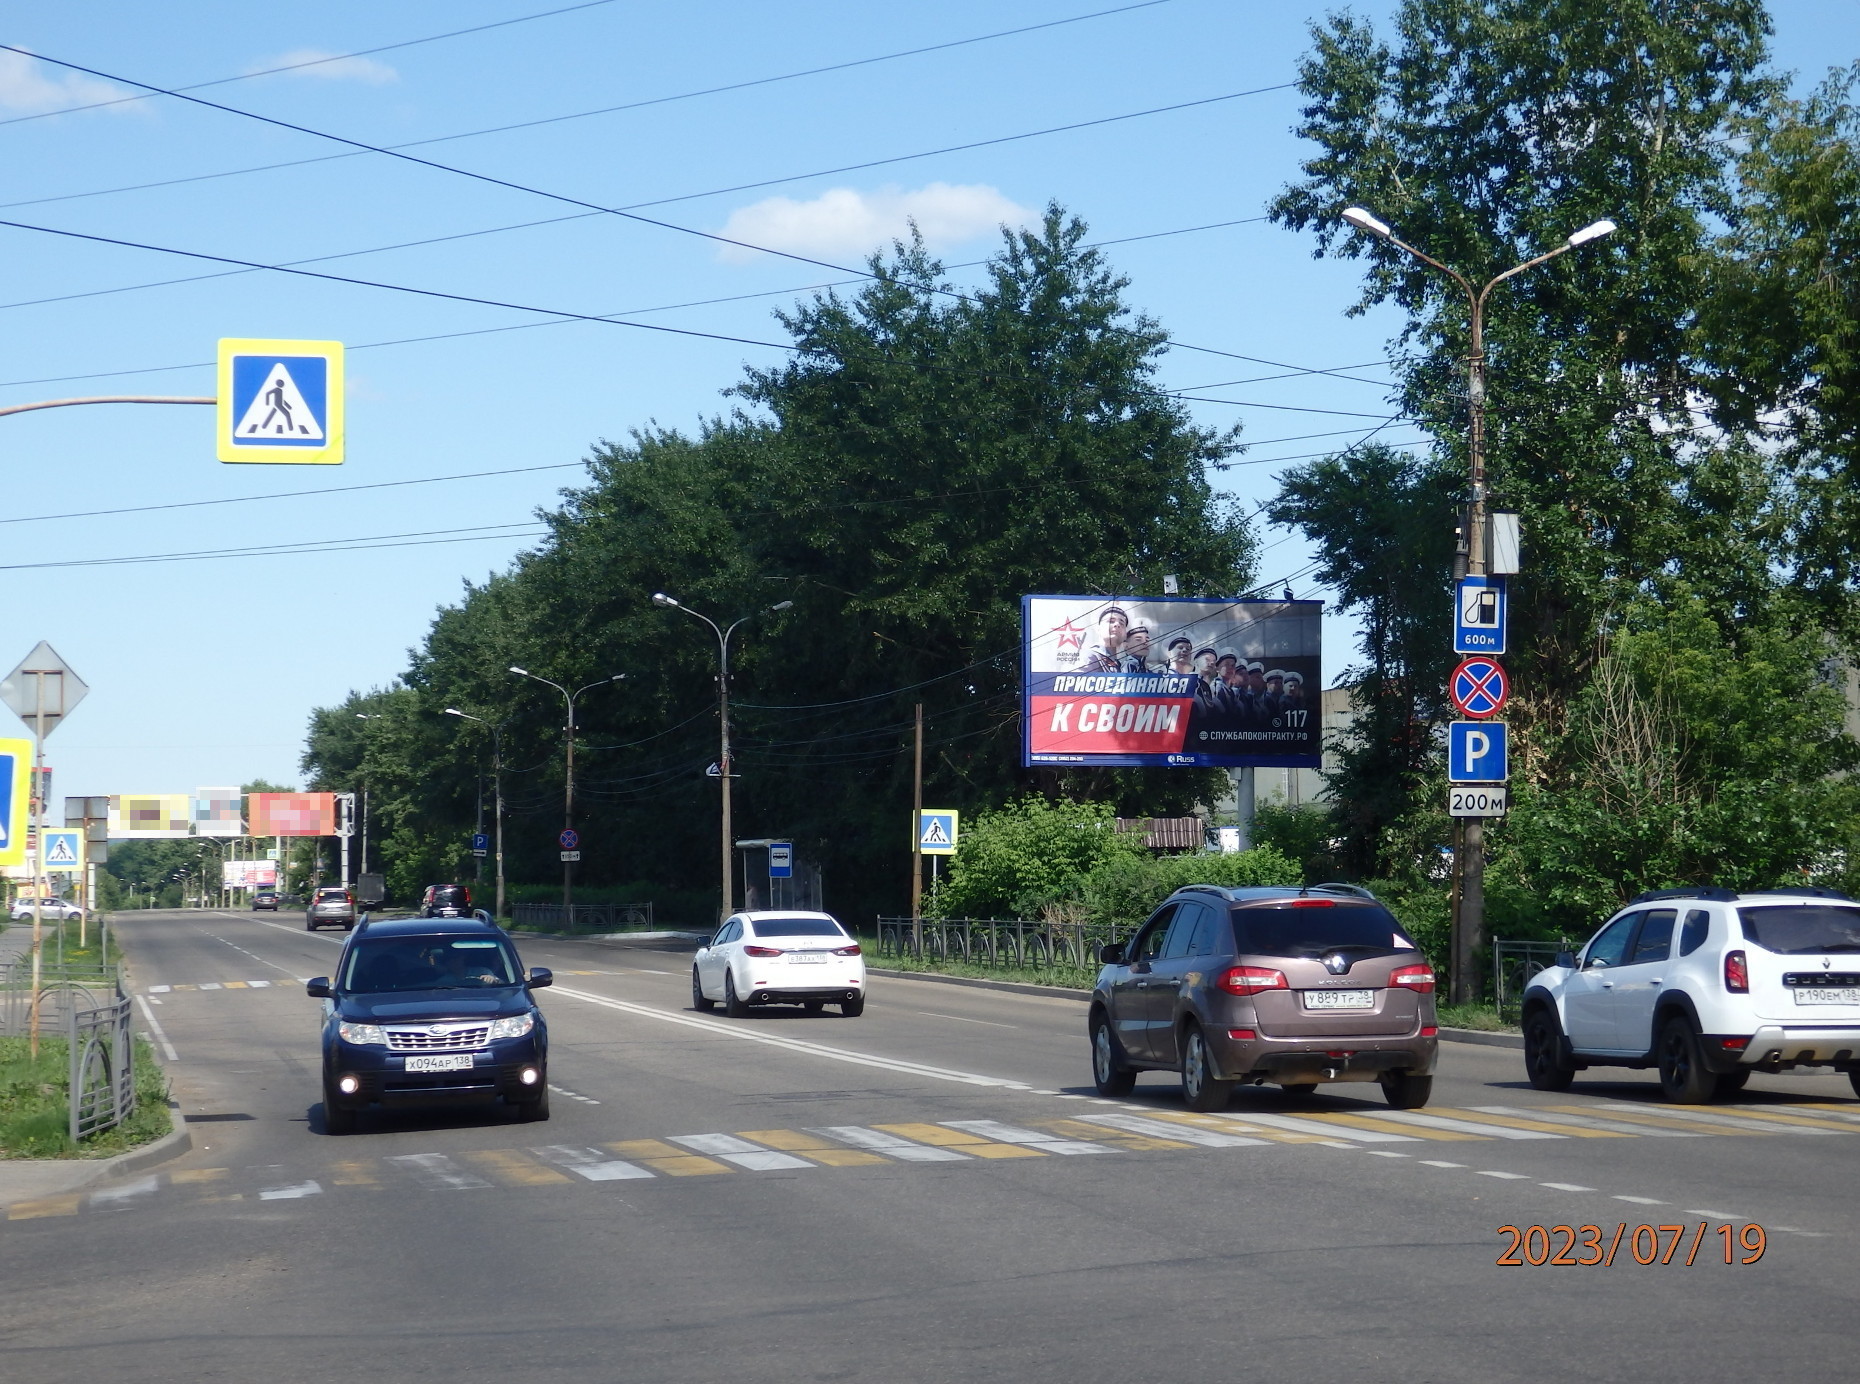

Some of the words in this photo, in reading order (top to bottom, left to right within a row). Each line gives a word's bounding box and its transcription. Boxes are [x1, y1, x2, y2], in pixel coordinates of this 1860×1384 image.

[1053, 674, 1190, 694] ПРИСОЕДИНЯЙСЯ
[1050, 703, 1074, 732] К
[1077, 703, 1181, 733] СВОИМ
[1284, 709, 1308, 728] 117
[1210, 731, 1308, 741] СЛУЖБАПОКОНТРАКТУ.РФ
[1466, 730, 1490, 773] P
[476, 836, 484, 847] P
